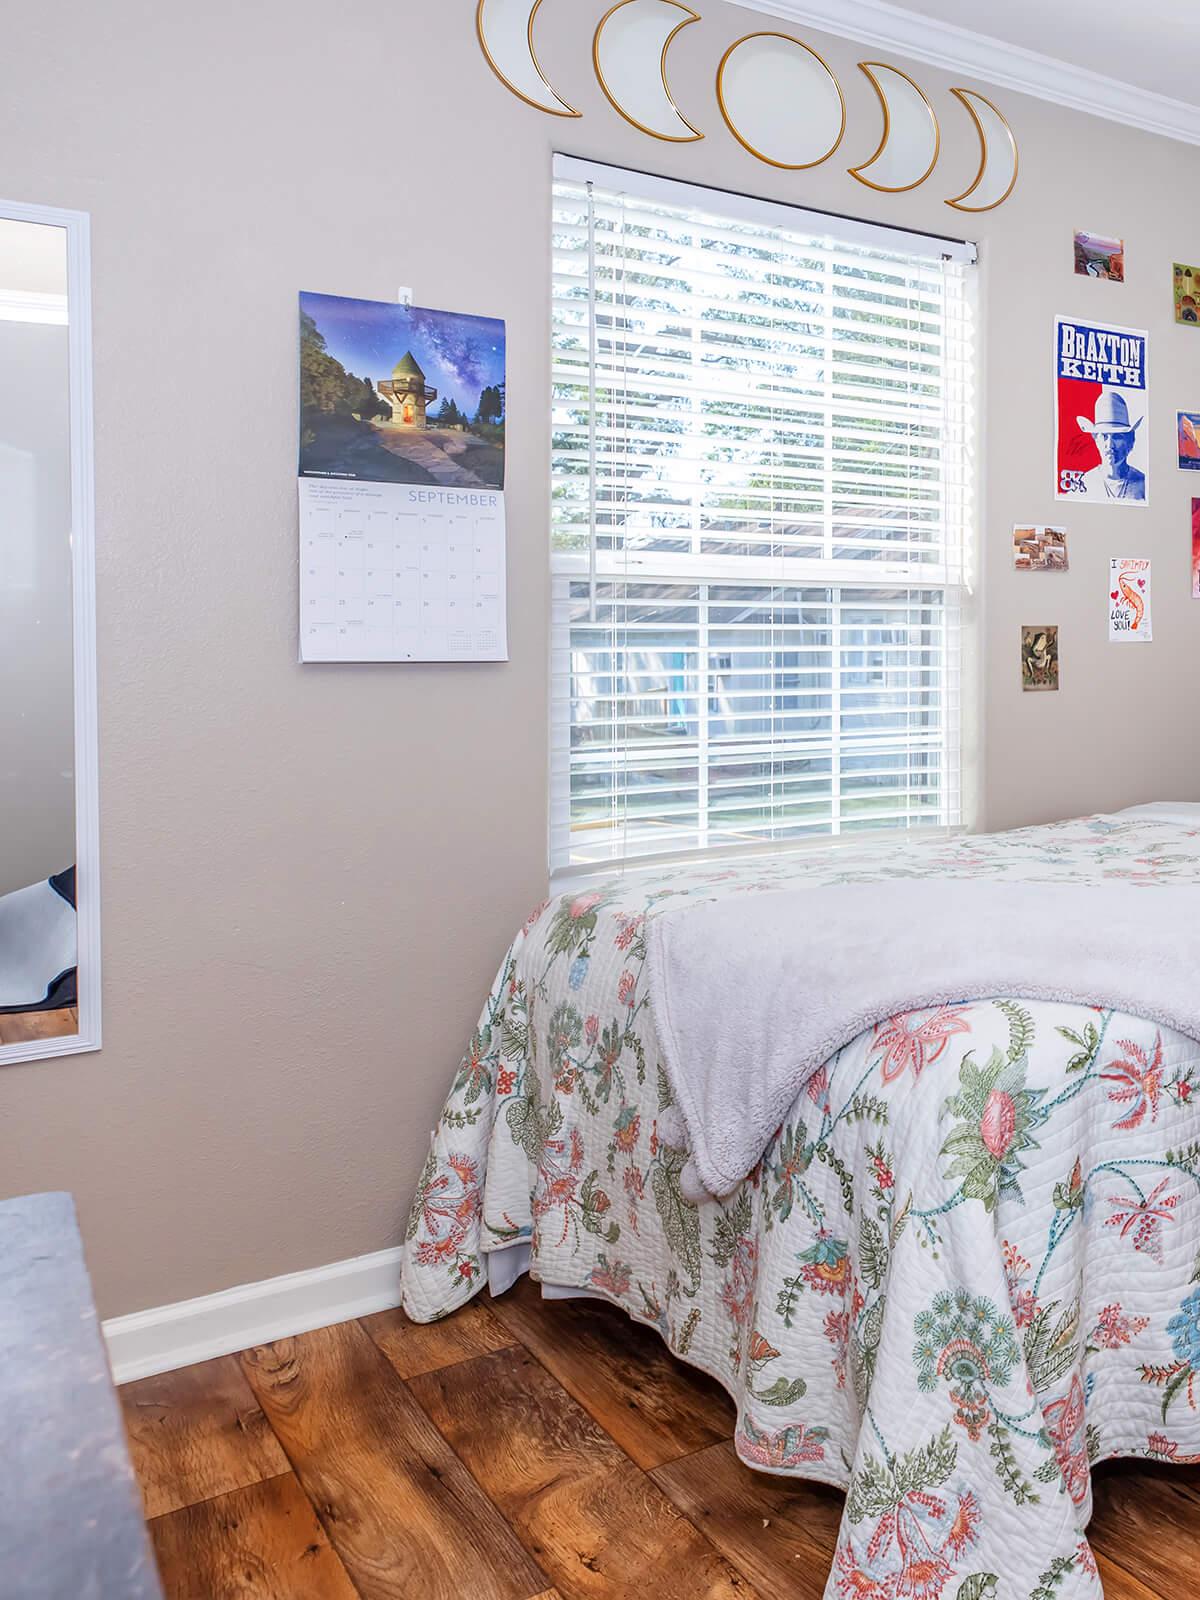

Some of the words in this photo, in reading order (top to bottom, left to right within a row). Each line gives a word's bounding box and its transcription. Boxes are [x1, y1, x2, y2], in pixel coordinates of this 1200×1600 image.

[1061, 325, 1140, 368] BRAXTON
[1061, 357, 1140, 386] KEITH
[408, 490, 497, 506] SEPTEMBER
[1112, 559, 1118, 568] I
[1111, 610, 1130, 621] LOVE
[1113, 620, 1131, 631] YOU!
